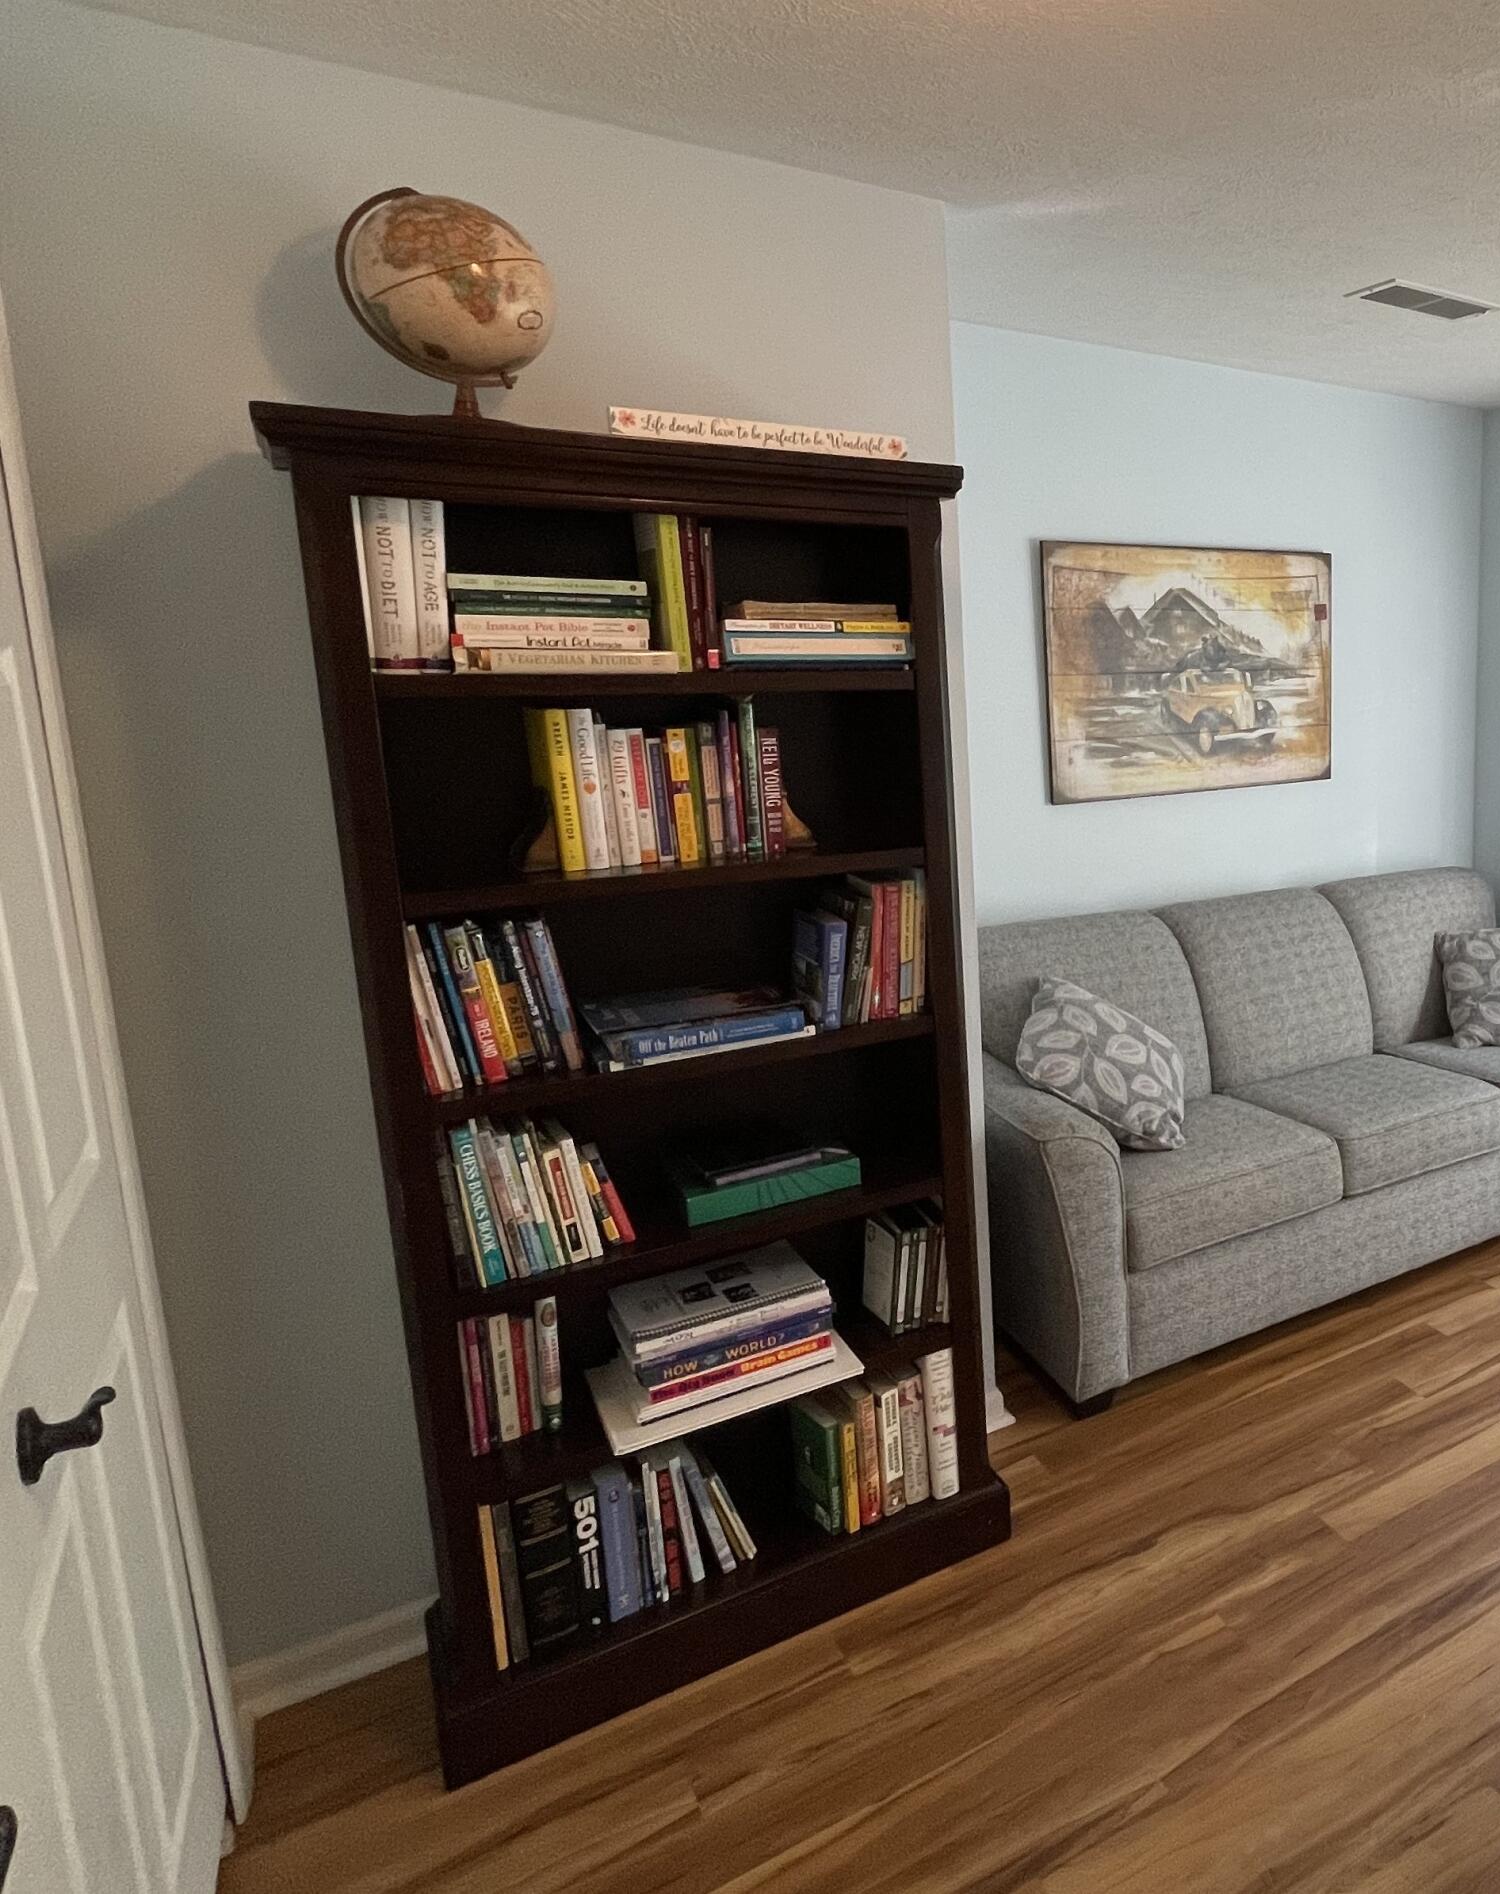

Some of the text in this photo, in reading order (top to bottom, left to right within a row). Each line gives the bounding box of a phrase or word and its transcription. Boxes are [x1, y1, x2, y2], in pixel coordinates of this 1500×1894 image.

[641, 414, 666, 435] Life
[710, 419, 734, 437] have
[737, 426, 749, 439] to
[751, 425, 762, 439] be
[762, 428, 799, 447] perfect
[799, 432, 811, 445] to
[813, 431, 824, 445] be
[826, 432, 883, 455] Wonderful
[376, 526, 394, 559] NOT
[421, 527, 436, 559] NOT
[381, 580, 398, 618] DIET
[424, 582, 439, 613] AGE
[486, 621, 530, 632] Instant
[535, 622, 554, 632] Pot
[559, 622, 588, 632] Bible
[526, 635, 567, 648] Instant
[571, 635, 591, 648] Pot
[552, 721, 564, 757] BREATH
[577, 727, 593, 760] Good
[764, 768, 781, 807] YOUNG
[558, 771, 575, 840] JAMES NESTOR
[507, 996, 526, 1040] PARIS
[475, 1019, 498, 1058] IRELAND
[700, 1028, 718, 1044] Path
[459, 1144, 497, 1253] CHESS BASICS BOOK
[663, 1361, 698, 1379] HOW
[741, 1342, 818, 1374] Brain Games
[574, 1496, 599, 1553] 501
